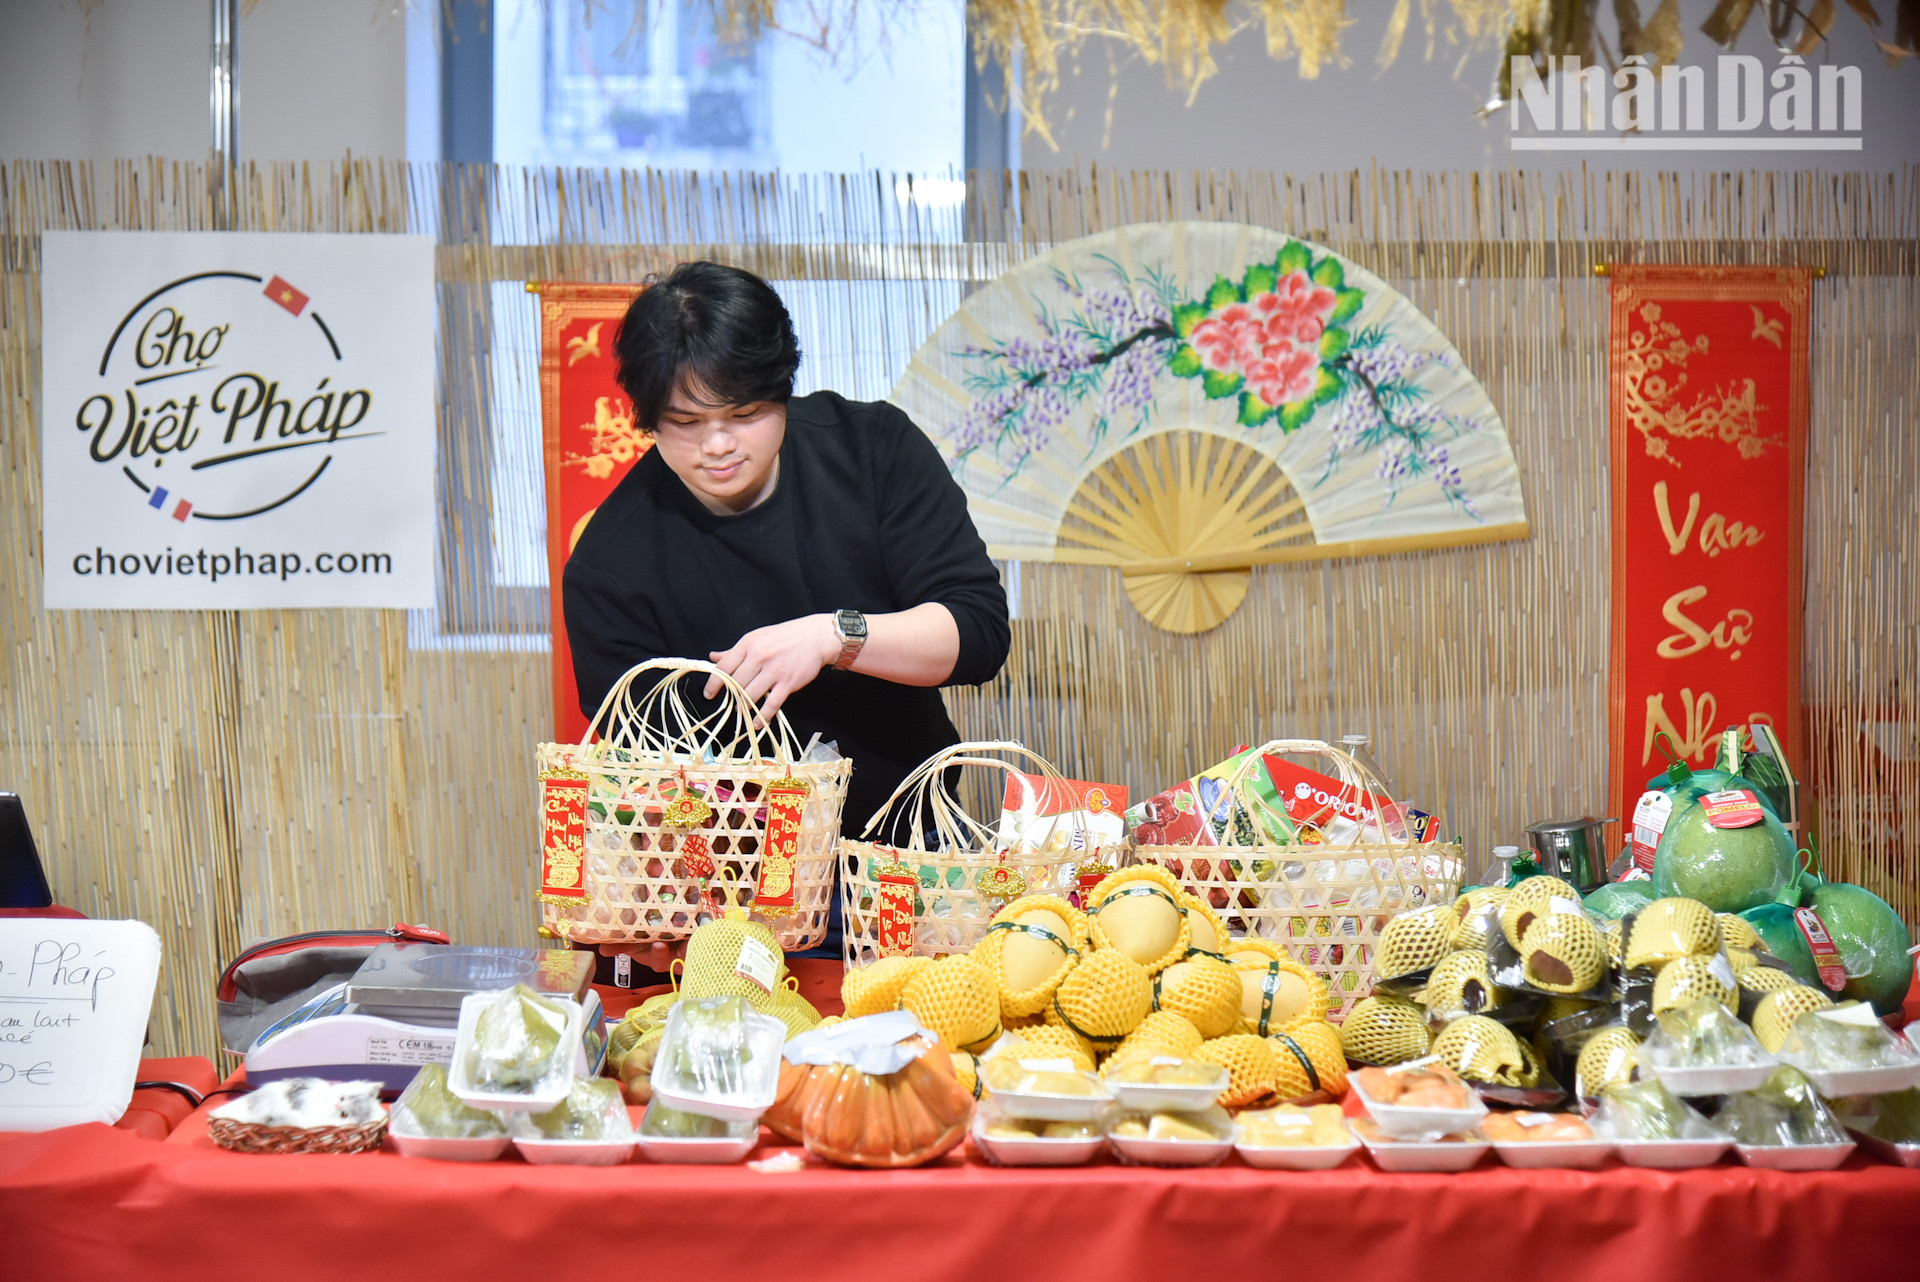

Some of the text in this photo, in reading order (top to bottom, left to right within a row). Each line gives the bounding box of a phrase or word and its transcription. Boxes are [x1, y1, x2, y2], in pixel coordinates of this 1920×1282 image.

[135, 306, 230, 368] Chợ
[76, 372, 371, 468] Việt Pháp
[1653, 480, 1765, 558] Vạn
[73, 547, 392, 582] chovietphap.com
[1657, 585, 1753, 661] Sự
